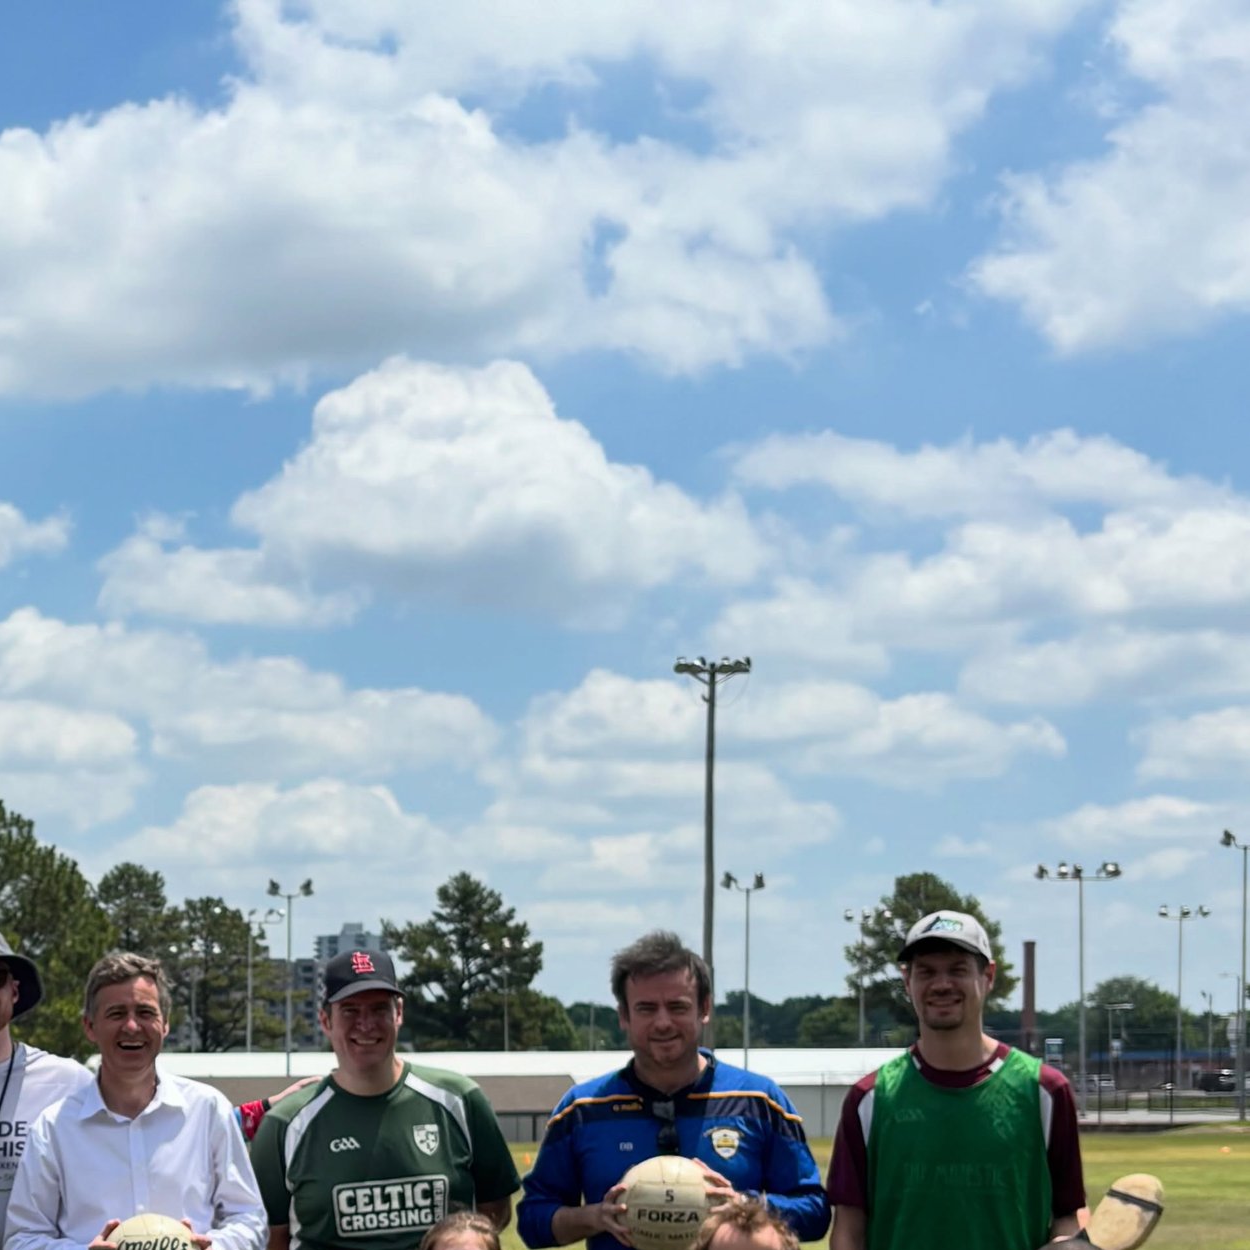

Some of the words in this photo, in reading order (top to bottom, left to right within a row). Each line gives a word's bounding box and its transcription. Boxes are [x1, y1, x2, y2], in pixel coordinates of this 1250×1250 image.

[330, 1137, 361, 1152] GAA
[338, 1182, 432, 1214] CELTIC
[665, 1189, 674, 1203] 5
[340, 1208, 433, 1231] CROSSING
[637, 1207, 699, 1223] FORZA
